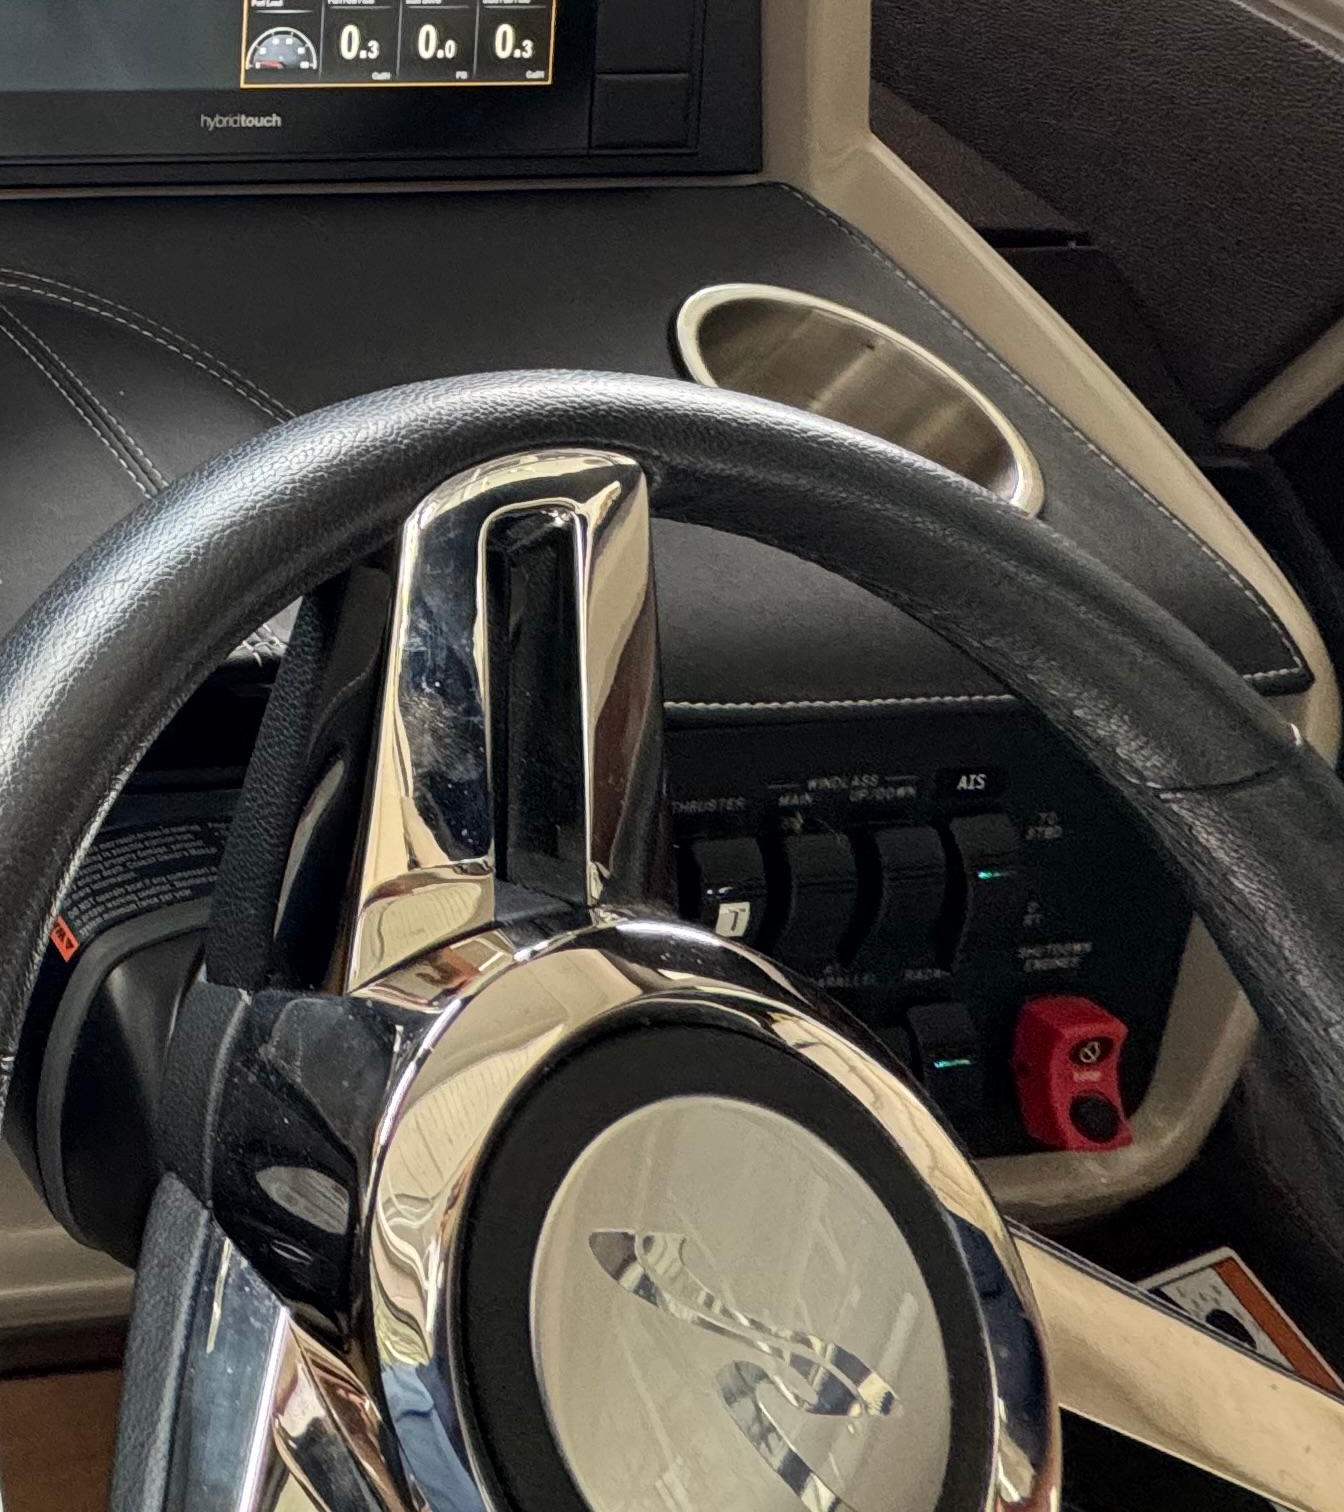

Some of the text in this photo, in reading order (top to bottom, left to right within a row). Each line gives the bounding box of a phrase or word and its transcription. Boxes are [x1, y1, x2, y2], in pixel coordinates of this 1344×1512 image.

[339, 23, 380, 60] 0.3
[417, 23, 457, 60] 0.0
[494, 23, 534, 59] 0.3
[200, 112, 282, 131] hybridtouch
[956, 773, 987, 791] AIS
